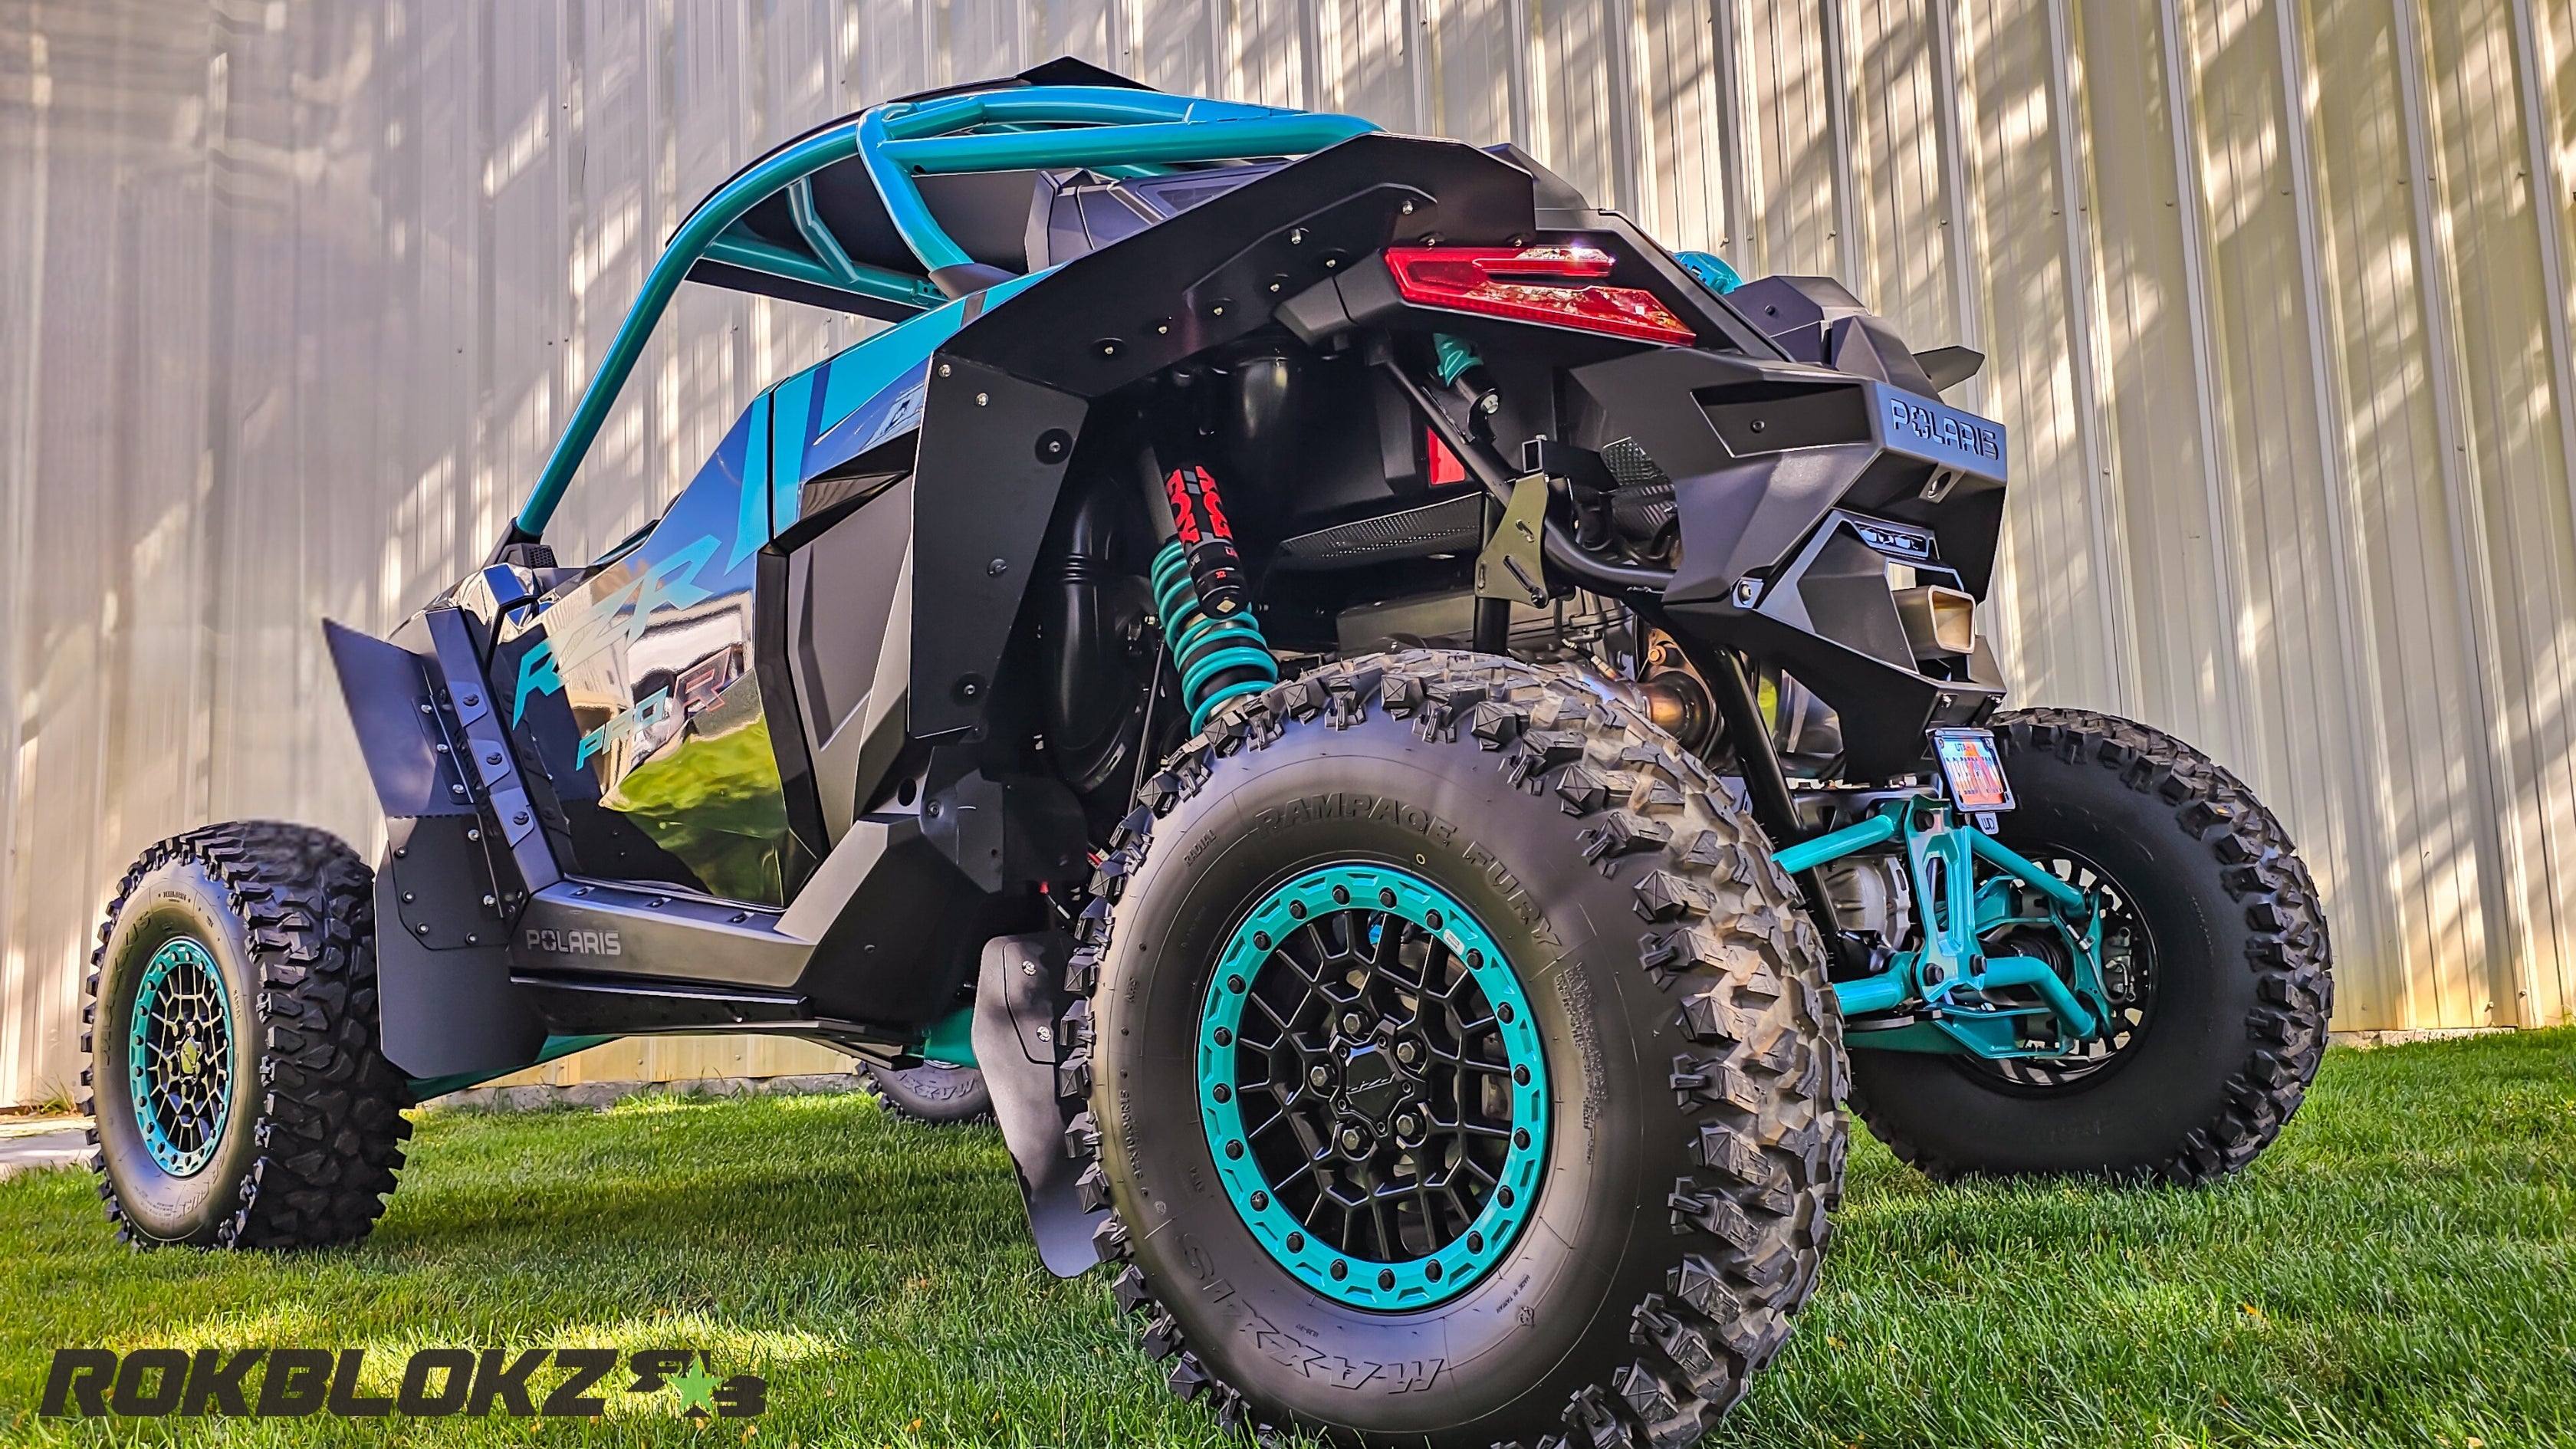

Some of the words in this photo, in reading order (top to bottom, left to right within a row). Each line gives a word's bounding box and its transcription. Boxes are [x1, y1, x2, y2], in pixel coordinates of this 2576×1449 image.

[1891, 398, 1999, 460] POLARIS
[512, 534, 721, 731] RZR
[576, 686, 669, 771] PRO
[1183, 828, 1217, 868] RADIAL
[1254, 792, 1457, 847] RAMPAGE
[1462, 840, 1562, 946] FURY
[526, 929, 621, 956] POLARIS
[1177, 1233, 1444, 1394] MAXXIS
